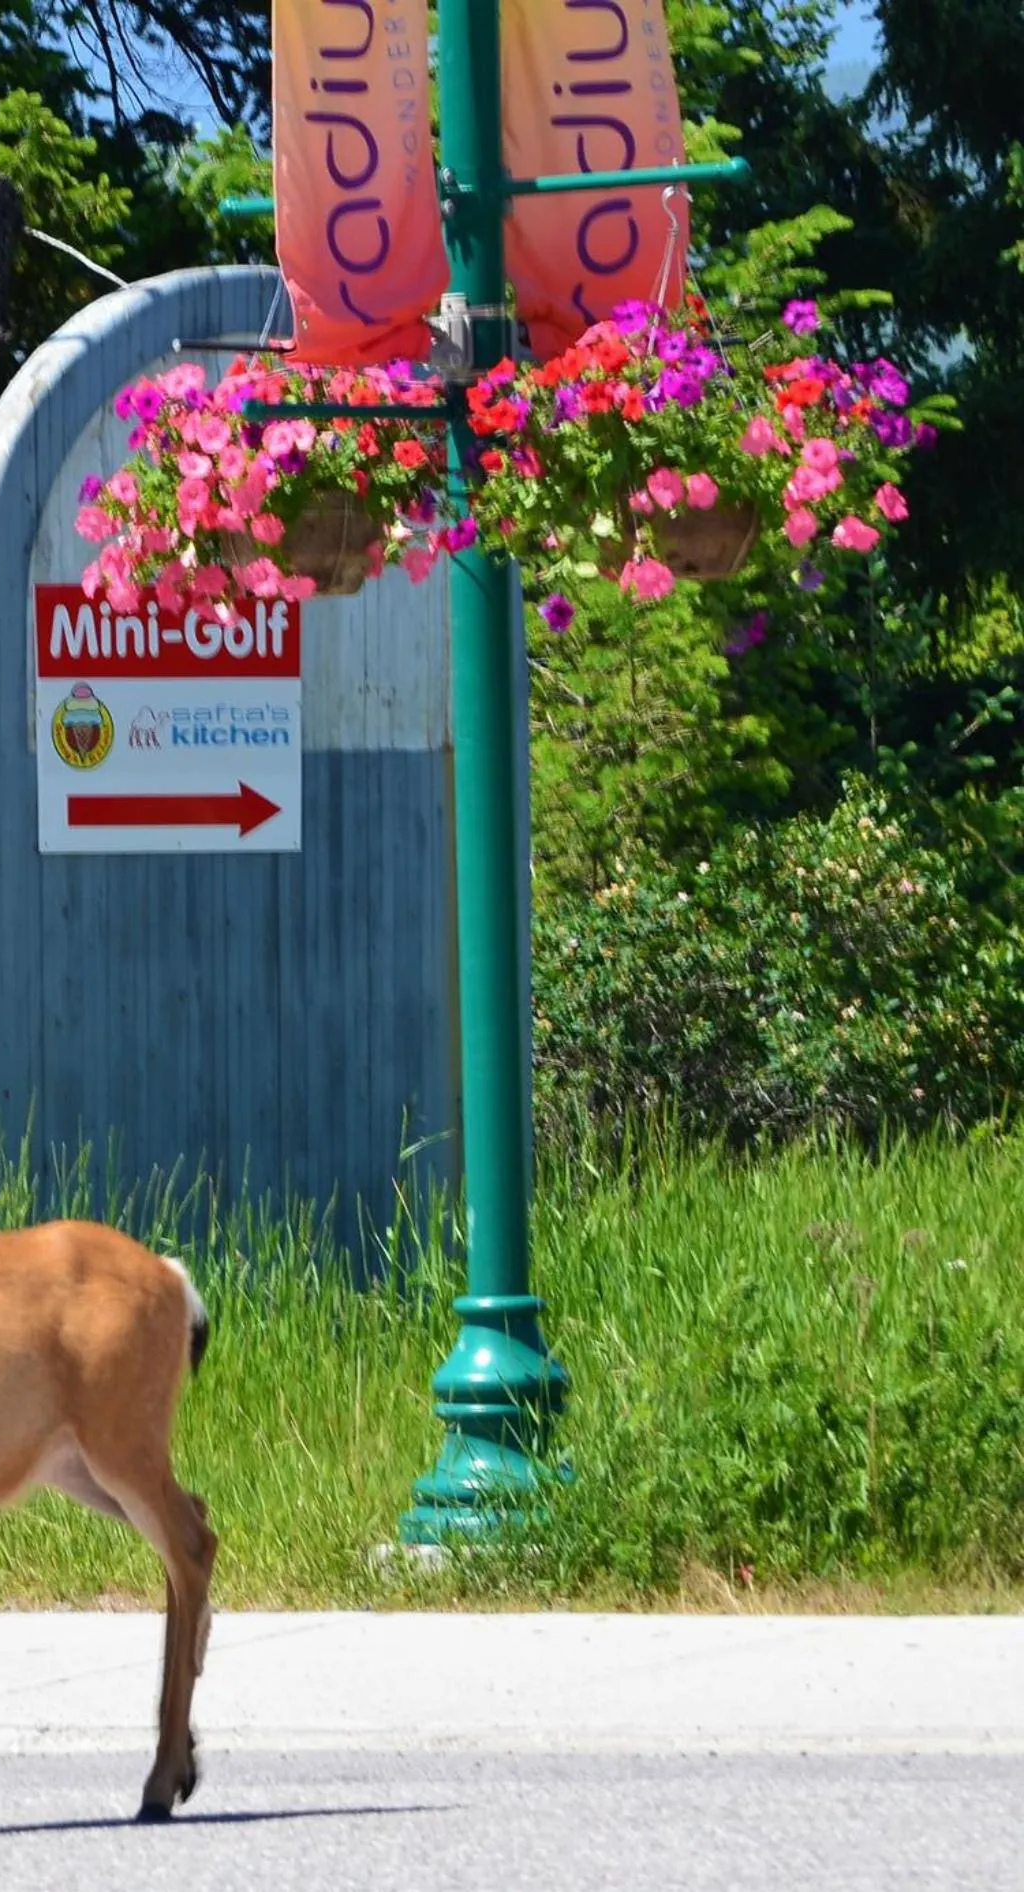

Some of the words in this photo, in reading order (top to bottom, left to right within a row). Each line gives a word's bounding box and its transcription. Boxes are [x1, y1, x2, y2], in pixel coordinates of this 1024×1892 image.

[641, 17, 674, 162] ONDER
[50, 600, 289, 659] Mini-Golf
[171, 702, 289, 722] safta's
[172, 724, 289, 745] kitchen
